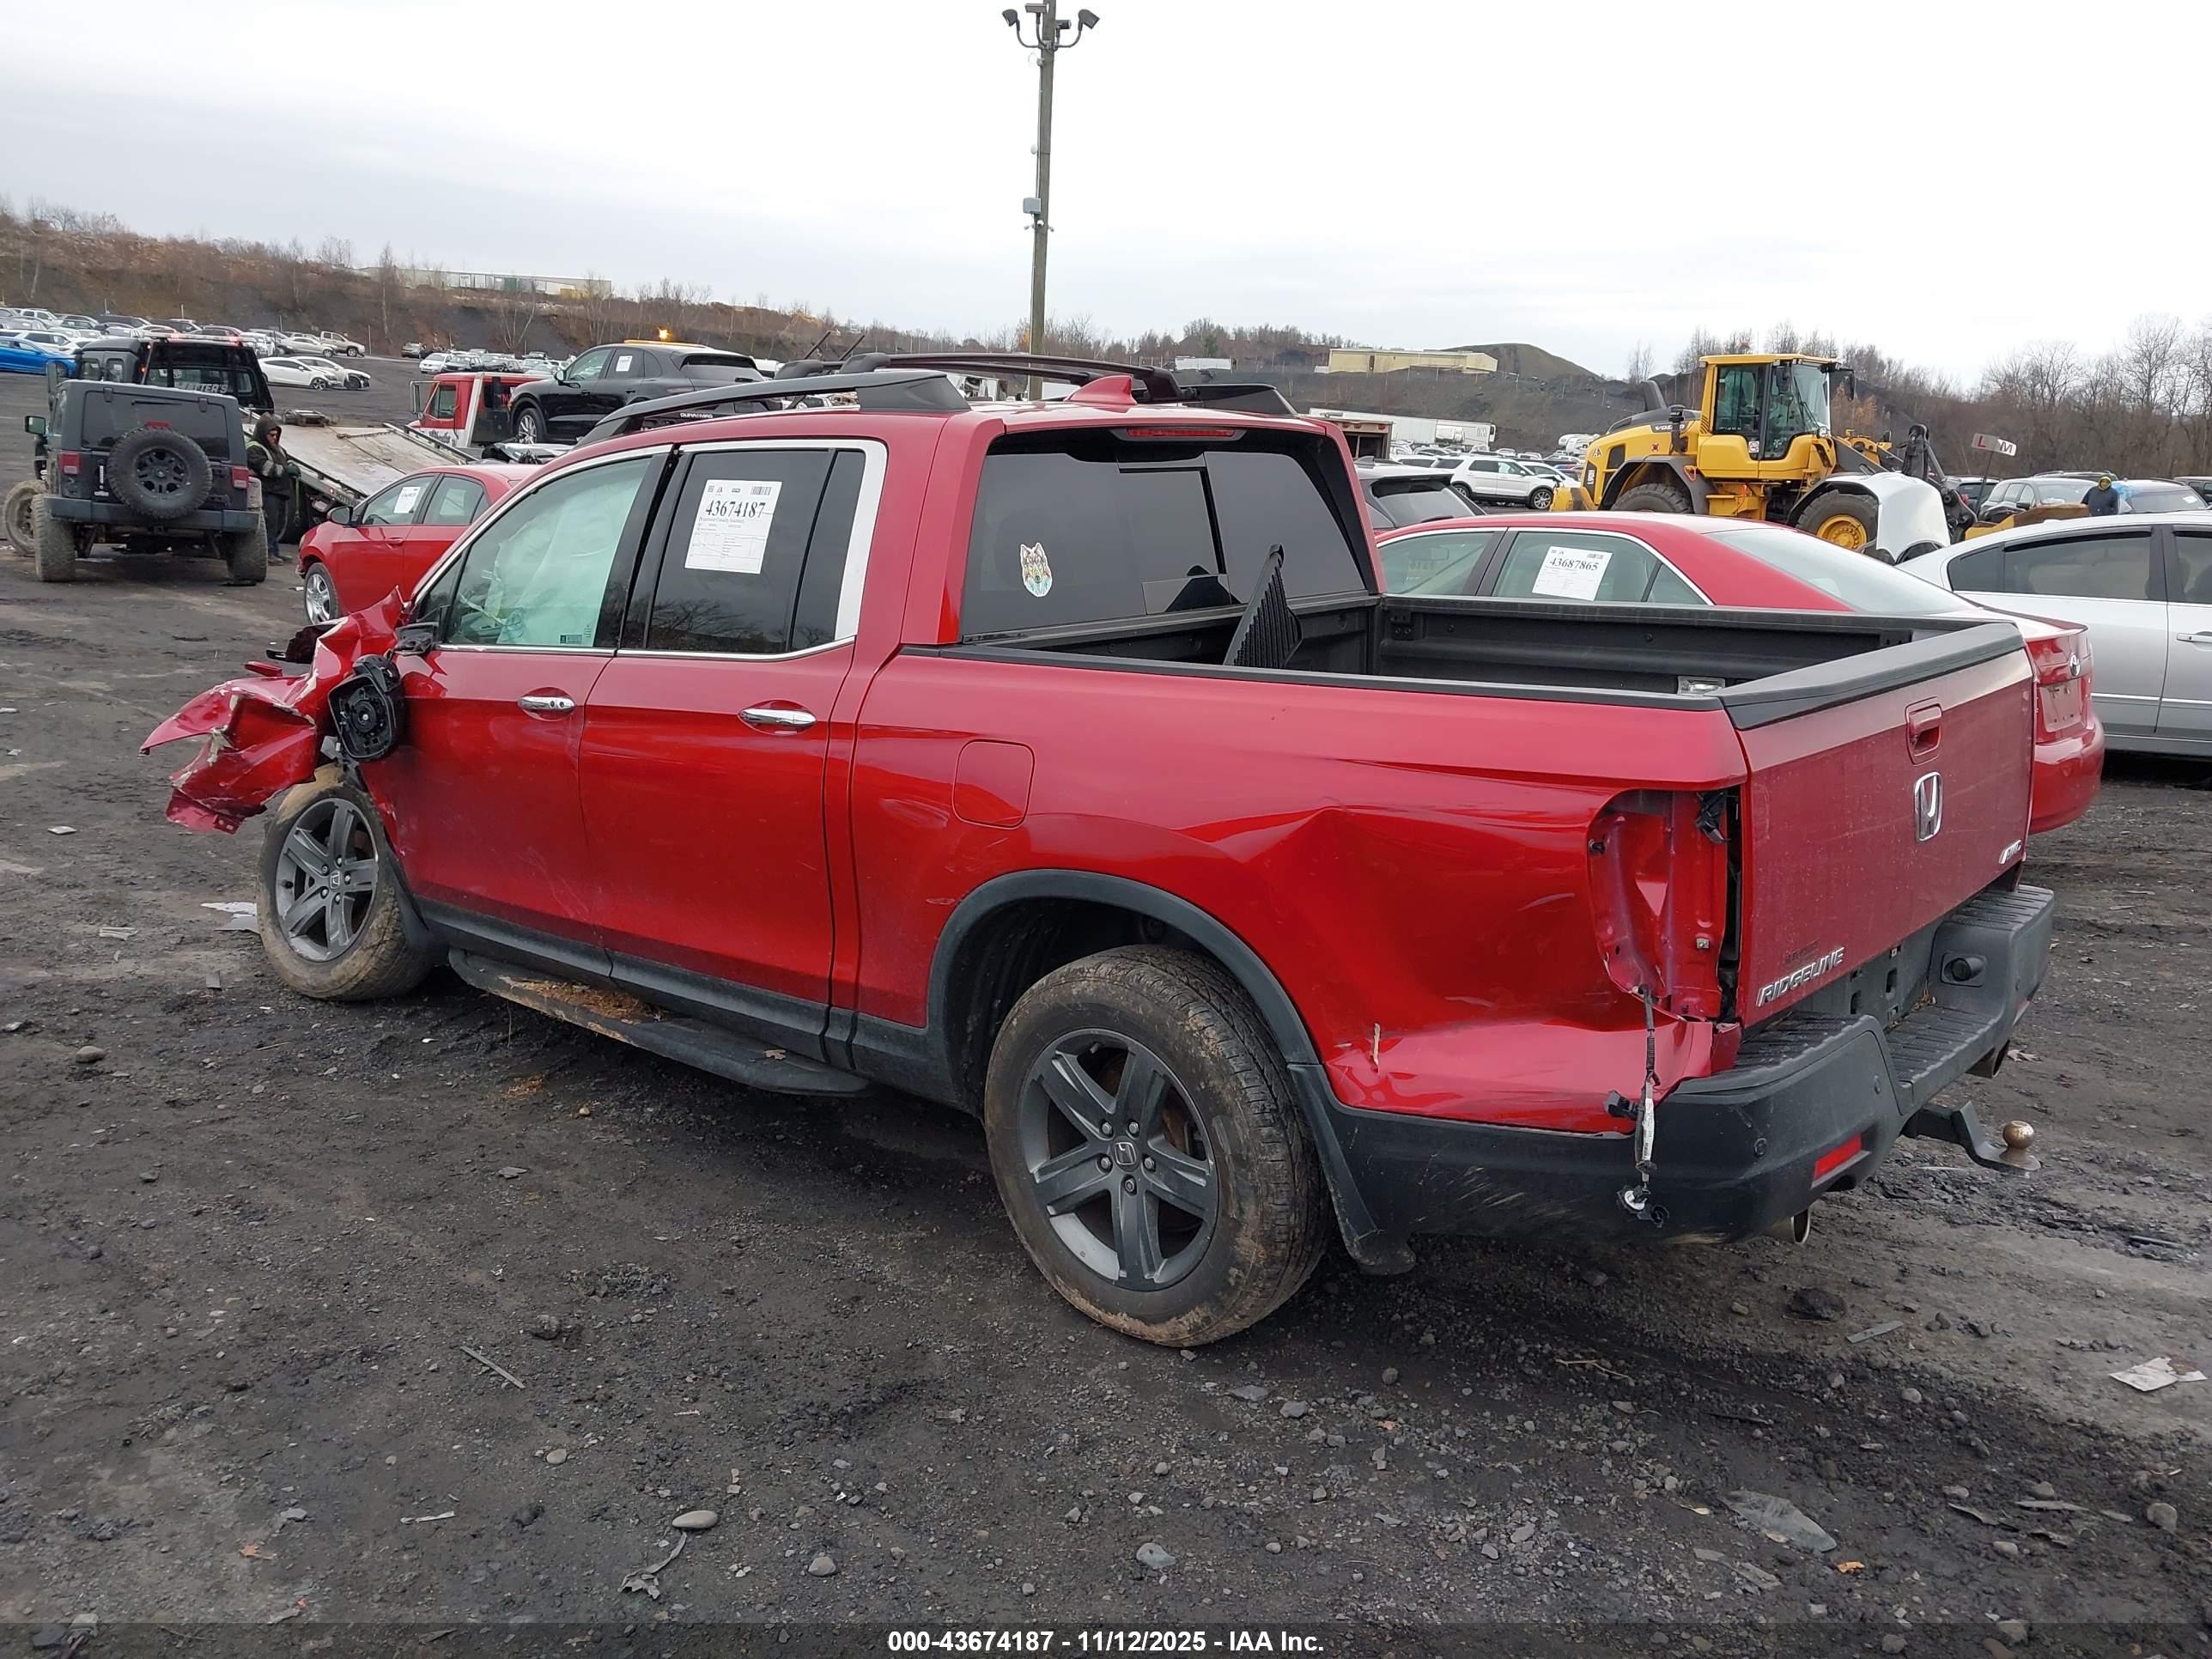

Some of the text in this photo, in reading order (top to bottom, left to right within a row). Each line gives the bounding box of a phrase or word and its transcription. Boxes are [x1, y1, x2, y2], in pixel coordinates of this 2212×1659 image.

[1977, 435, 2014, 454] L M
[705, 499, 766, 519] 43674187
[1549, 556, 1600, 571] 43687865
[1755, 945, 1845, 1007] RIDGELINE
